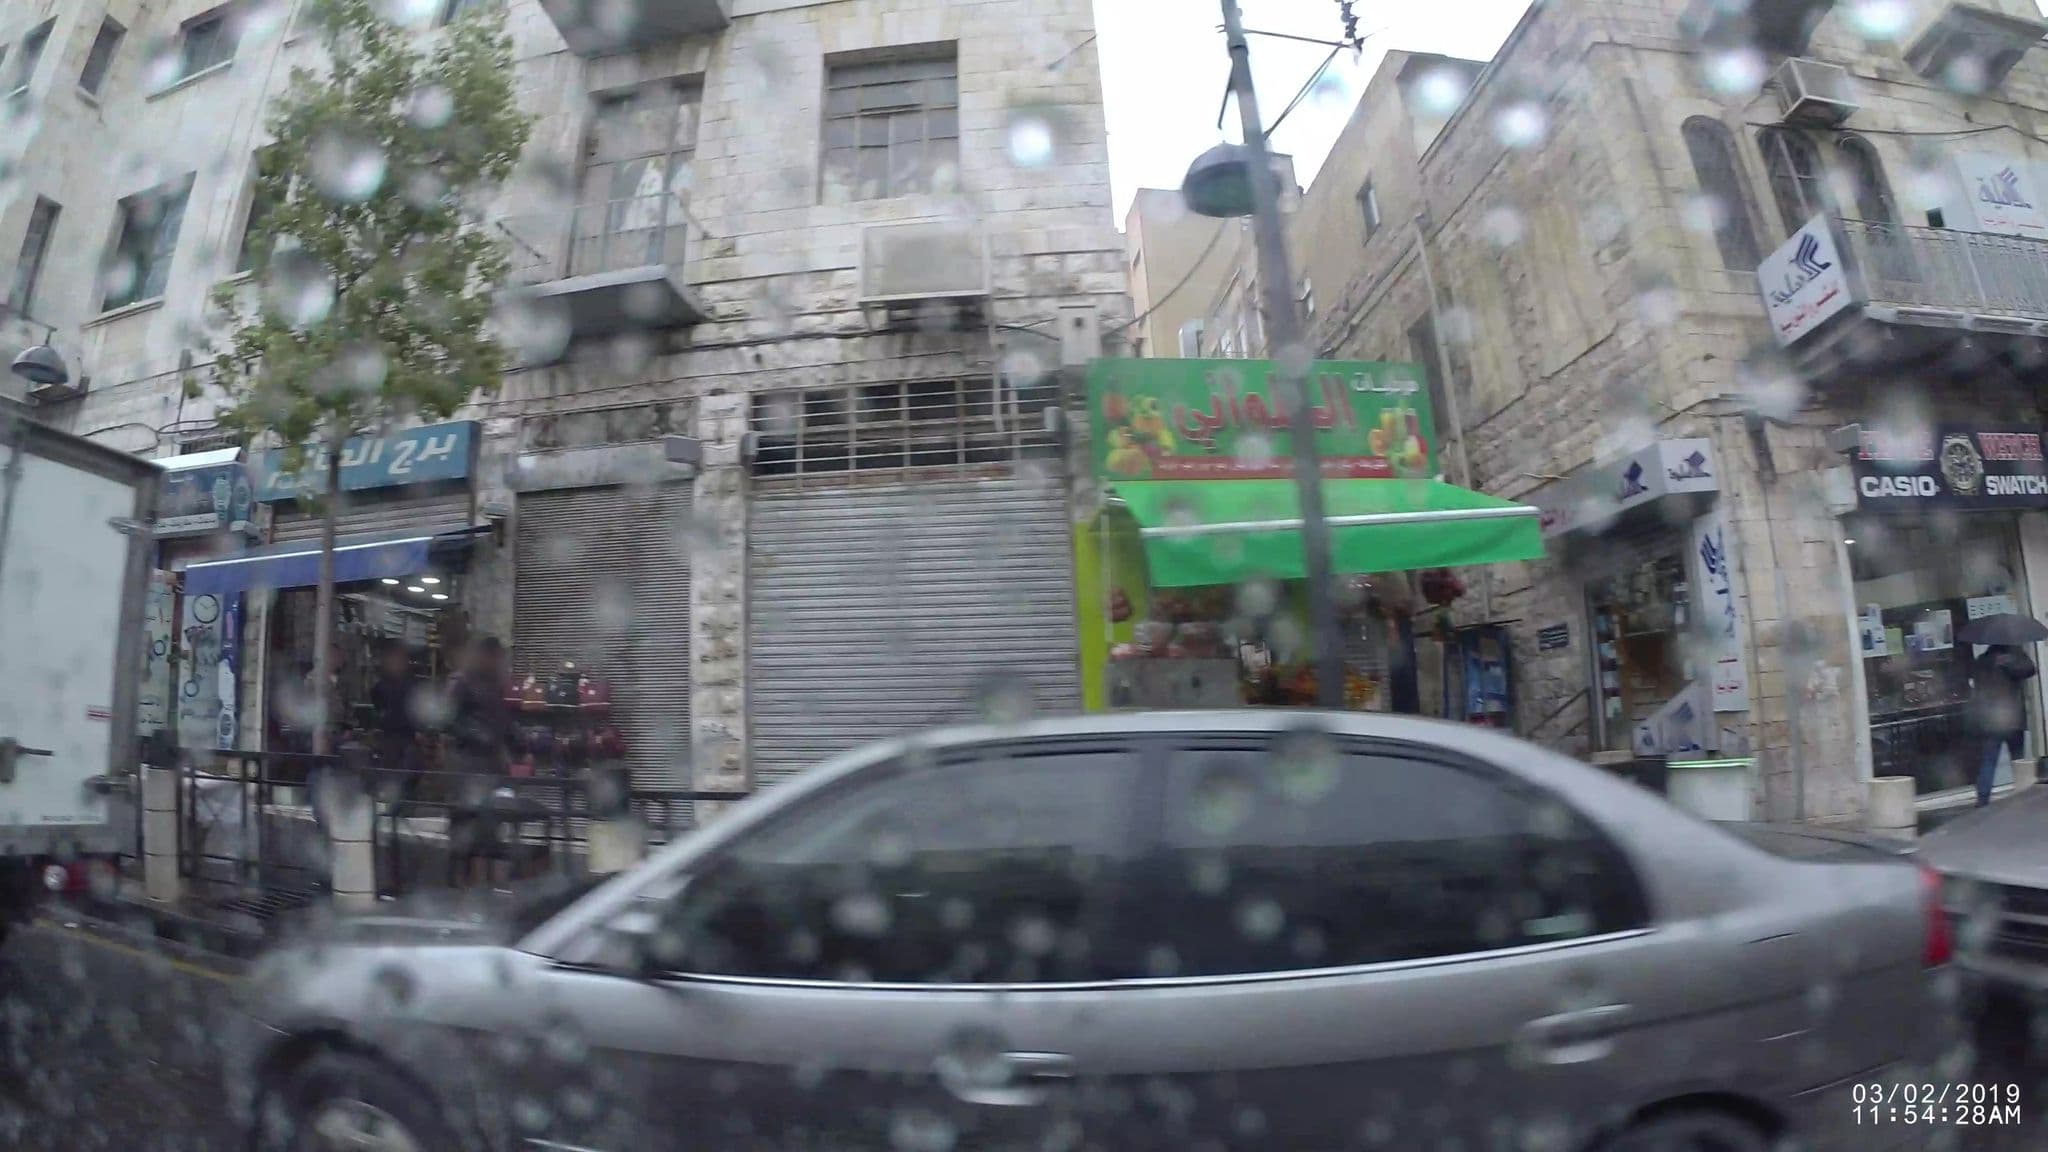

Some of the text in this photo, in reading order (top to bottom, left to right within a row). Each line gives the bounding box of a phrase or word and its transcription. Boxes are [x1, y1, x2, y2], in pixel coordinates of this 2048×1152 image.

[387, 433, 457, 475] برج
[1859, 475, 1938, 497] CASIO
[1985, 475, 2048, 495] SWATCH
